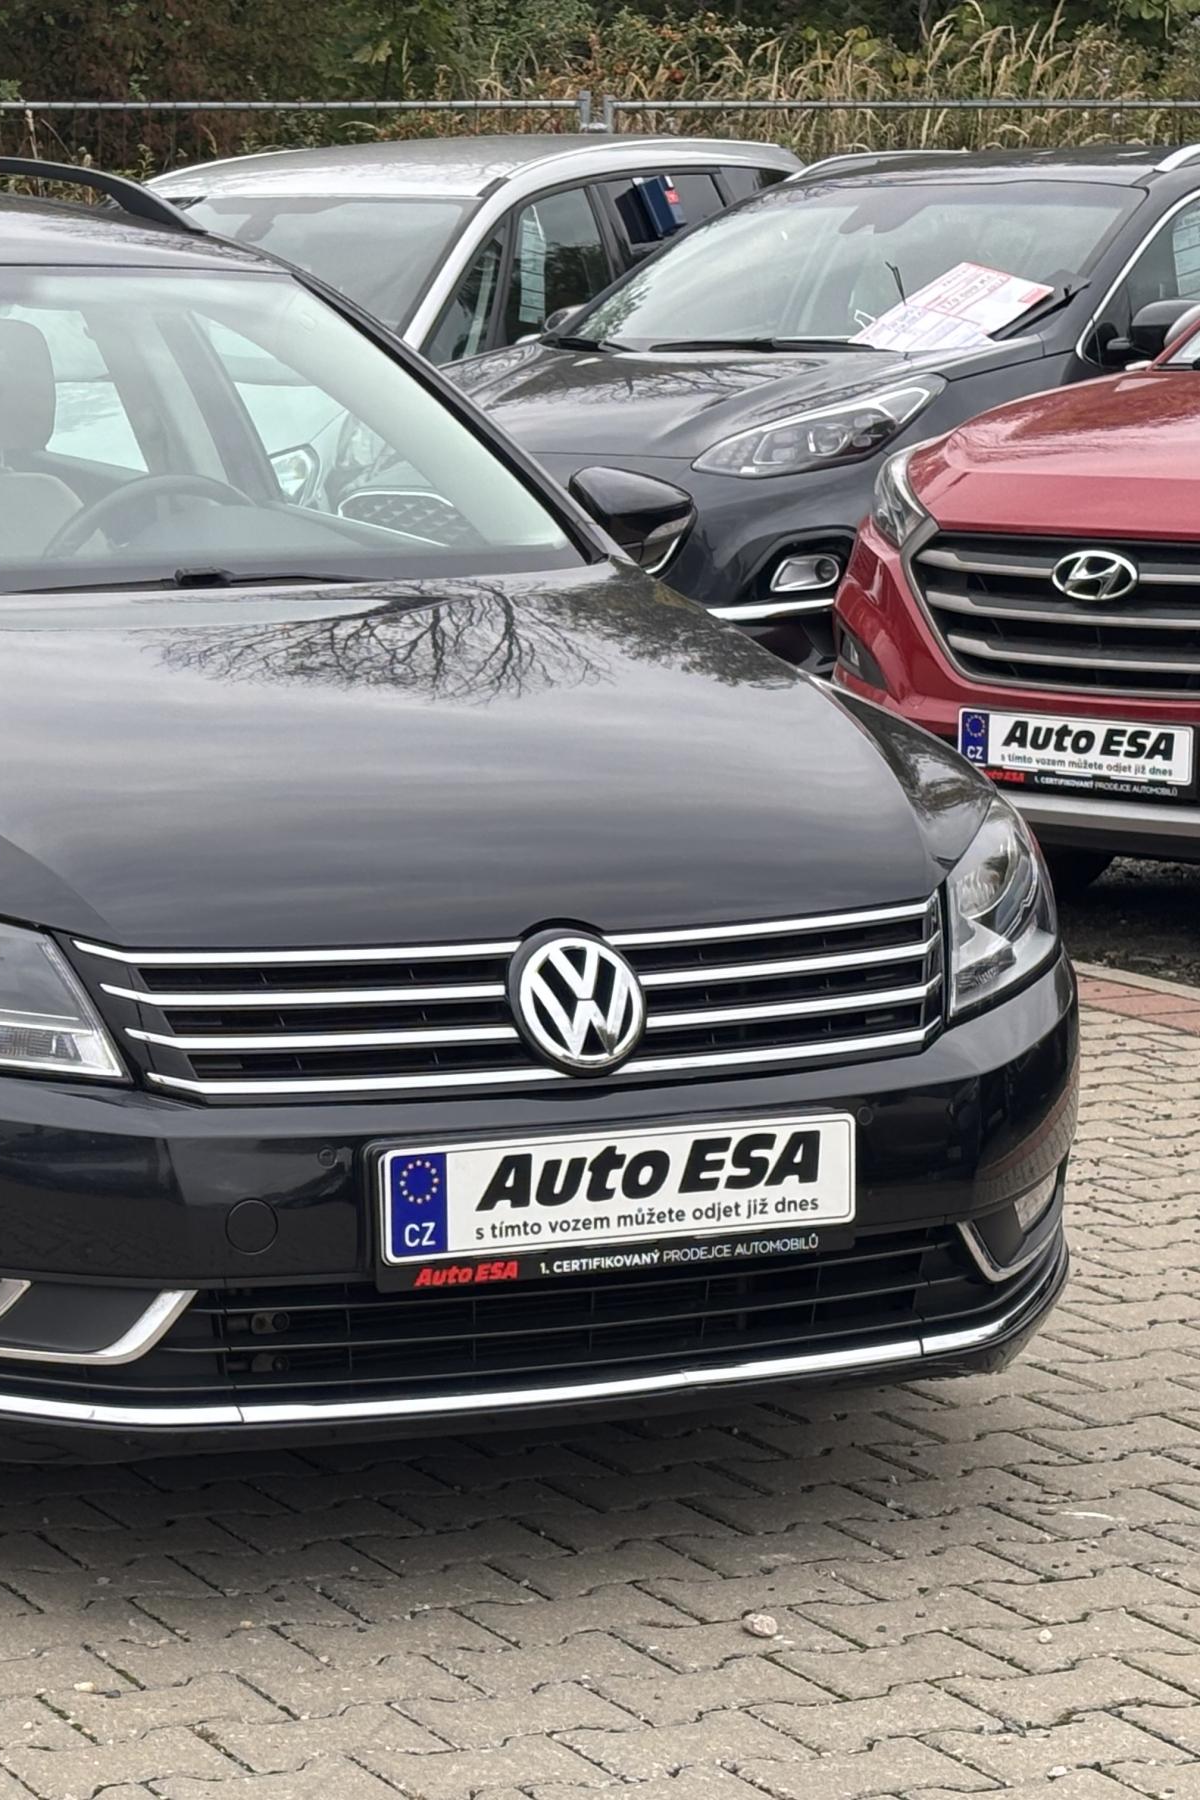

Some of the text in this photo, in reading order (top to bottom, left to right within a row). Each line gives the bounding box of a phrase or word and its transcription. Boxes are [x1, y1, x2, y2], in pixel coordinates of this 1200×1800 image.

[966, 745, 983, 760] CZ
[1001, 720, 1175, 761] Auto ESA
[1148, 766, 1173, 777] dnes
[475, 1130, 820, 1212] Auto ESA
[404, 1222, 436, 1247] CZ
[475, 1197, 819, 1240] s tímto vozem můžete odjet již dnes
[540, 1233, 819, 1275] 1. CERTIFIKOVANÝ PRODEJCE AUTOMOBILŮ
[414, 1260, 519, 1287] Auto ESA
